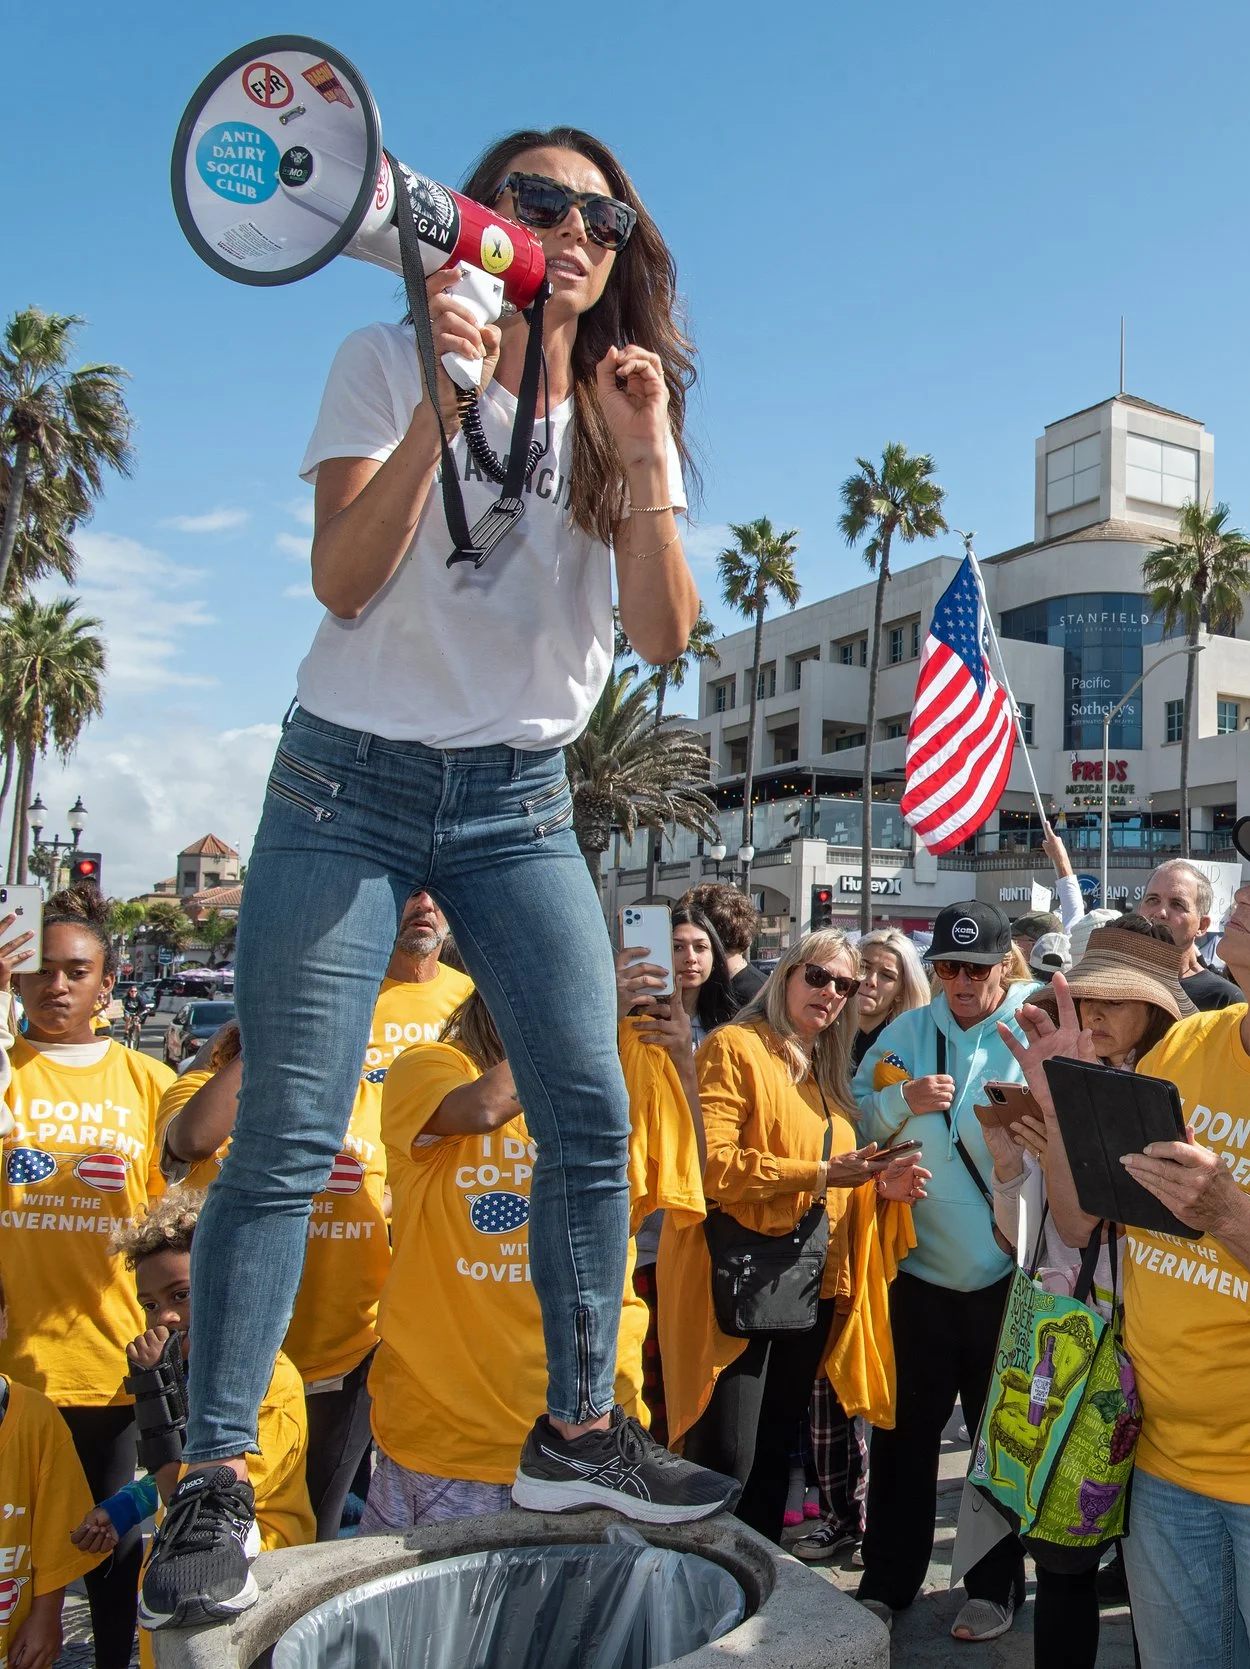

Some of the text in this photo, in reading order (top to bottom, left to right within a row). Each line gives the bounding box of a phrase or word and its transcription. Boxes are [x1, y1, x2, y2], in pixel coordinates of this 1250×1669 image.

[250, 74, 286, 100] FUR
[221, 130, 260, 144] ANTI
[212, 146, 266, 162] DAIRY
[206, 161, 265, 184] SOCIAL
[216, 179, 257, 199] CLUB
[1059, 612, 1149, 627] STANFIELD
[1071, 676, 1111, 690] Pacific
[1071, 760, 1128, 782] FRED'S
[1065, 784, 1136, 795] MEXICA CAFE
[842, 877, 887, 893] Huey
[385, 1019, 446, 1043] DON'
[14, 1095, 131, 1128] I DON'T
[3, 1123, 145, 1161] O-PARENT
[483, 1136, 491, 1158] I
[23, 1193, 101, 1209] WITH THE
[314, 1202, 334, 1214] HE
[0, 1210, 137, 1234] OVERNMENT
[1187, 1243, 1219, 1263] THE
